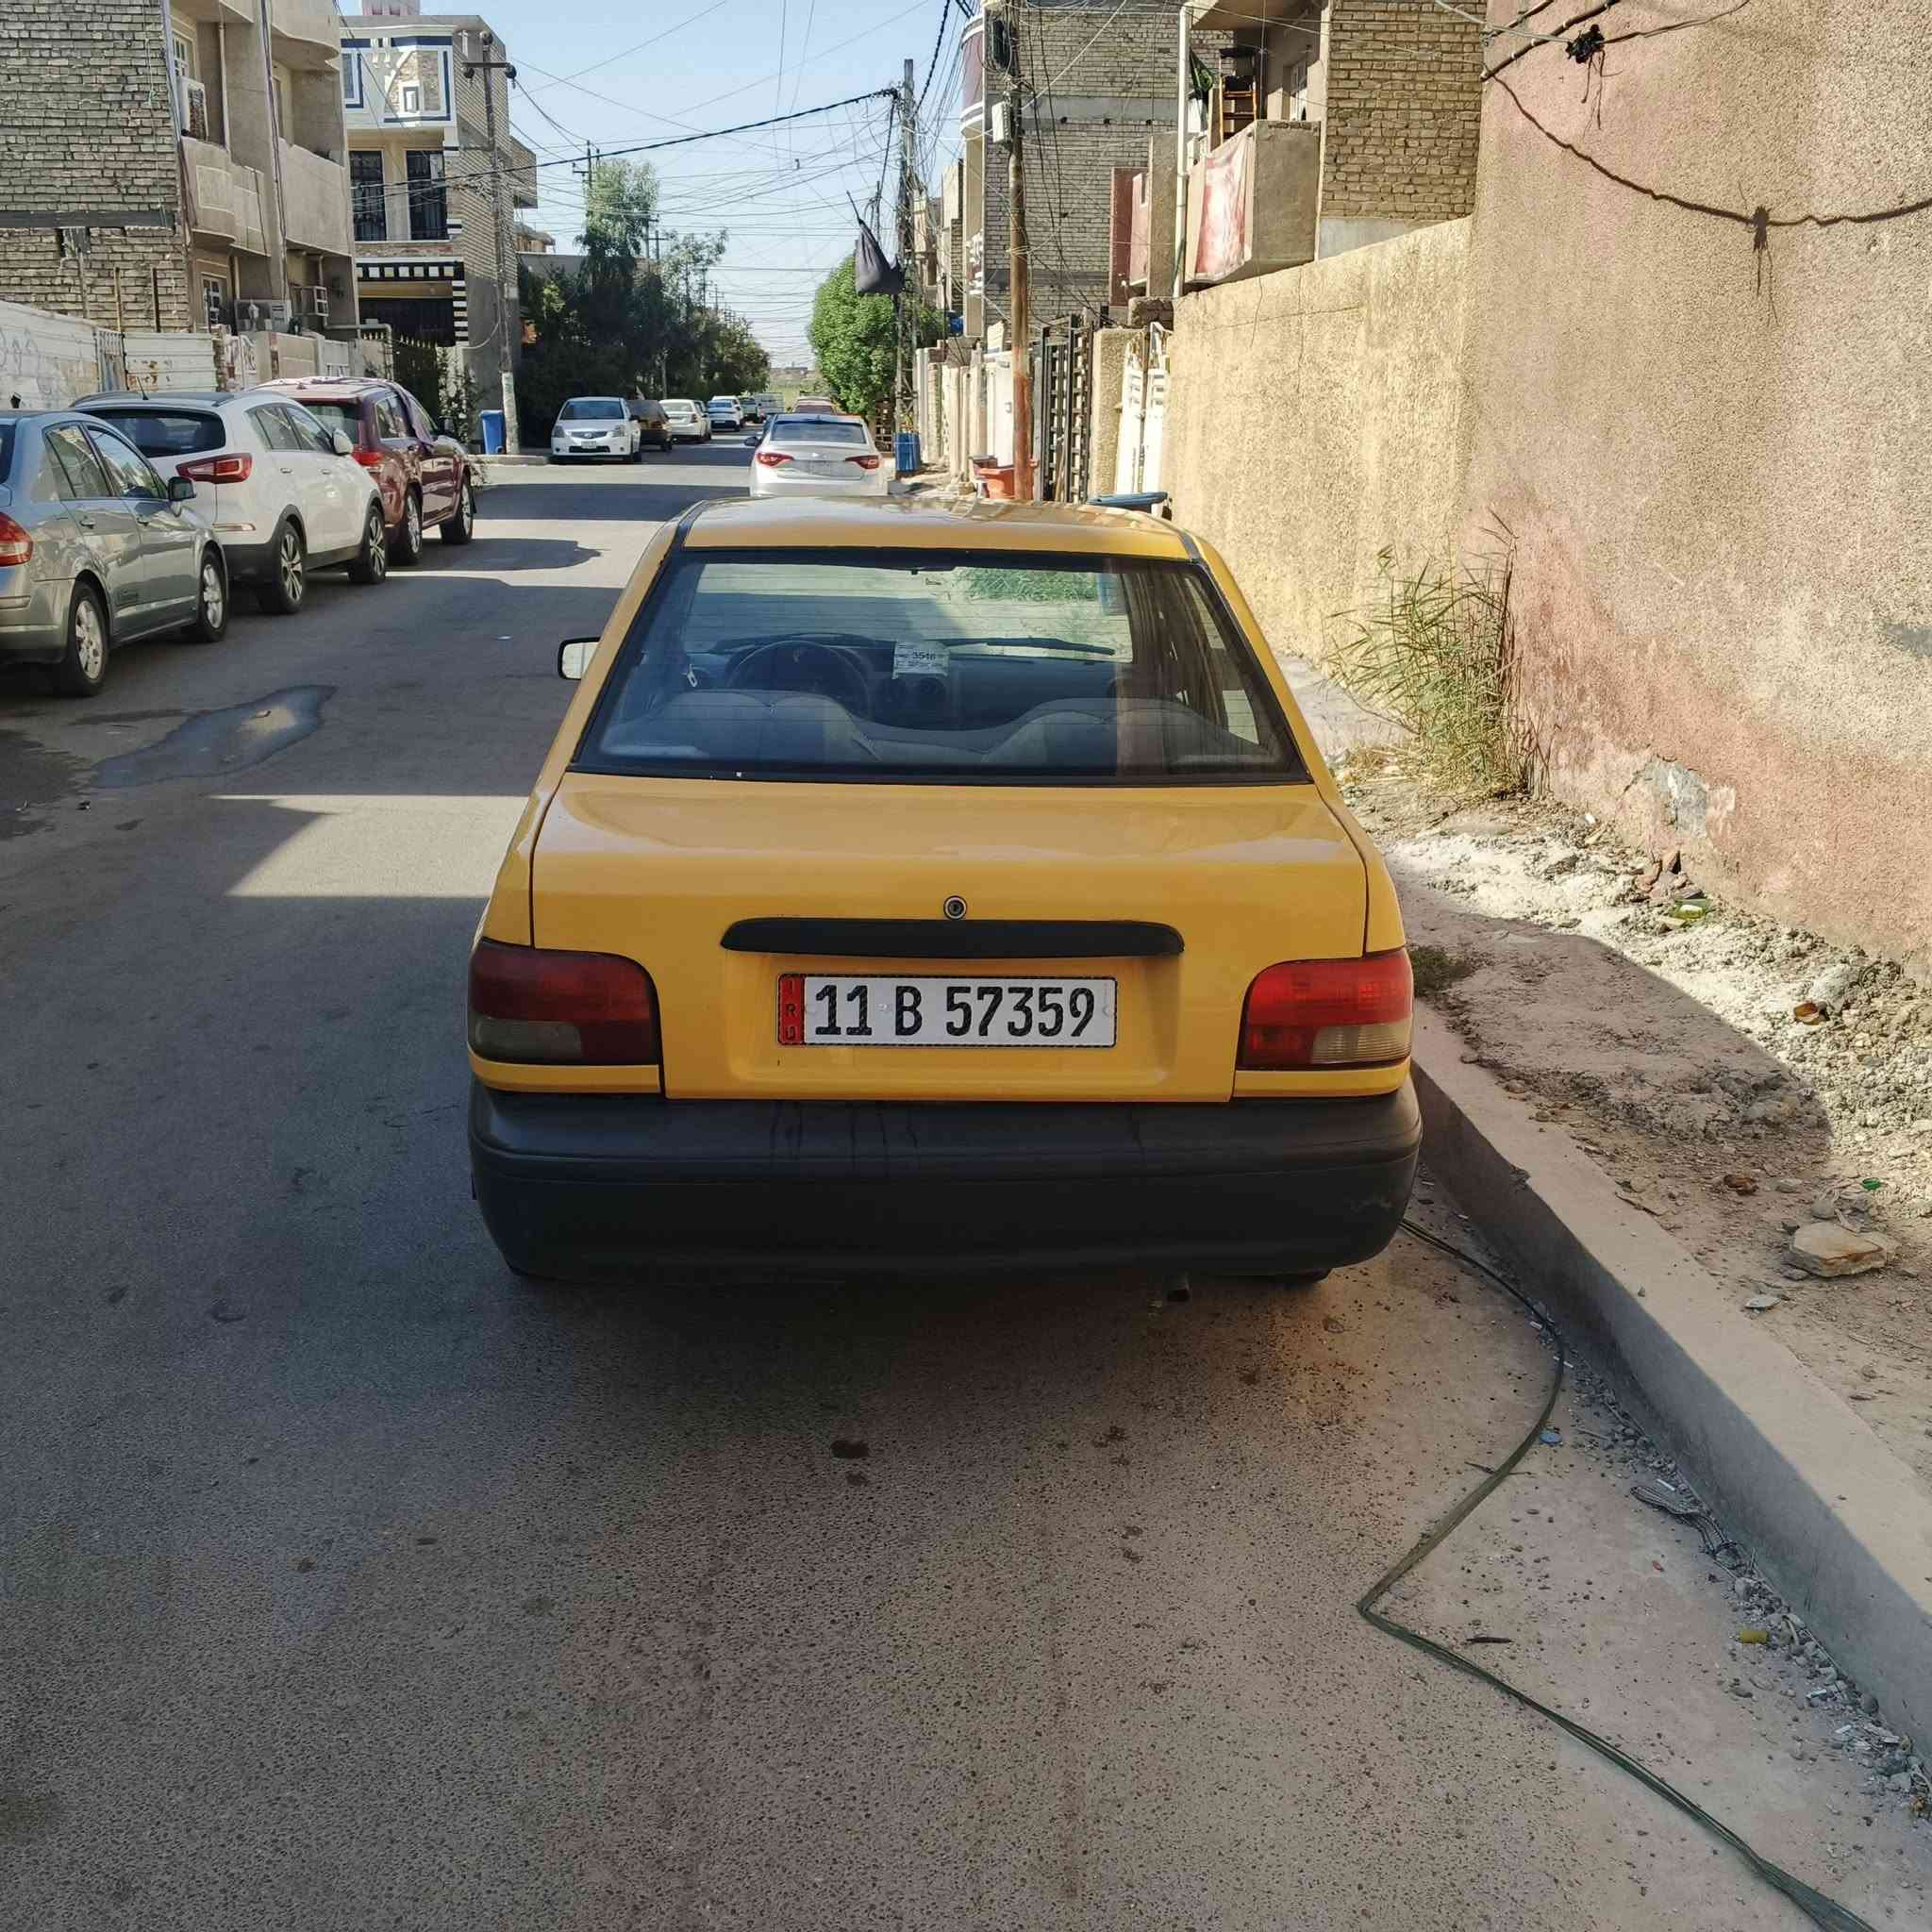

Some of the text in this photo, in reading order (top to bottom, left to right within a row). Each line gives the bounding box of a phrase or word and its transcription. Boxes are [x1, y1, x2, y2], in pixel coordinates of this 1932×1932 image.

[815, 984, 1095, 1037] 11 B 57359
